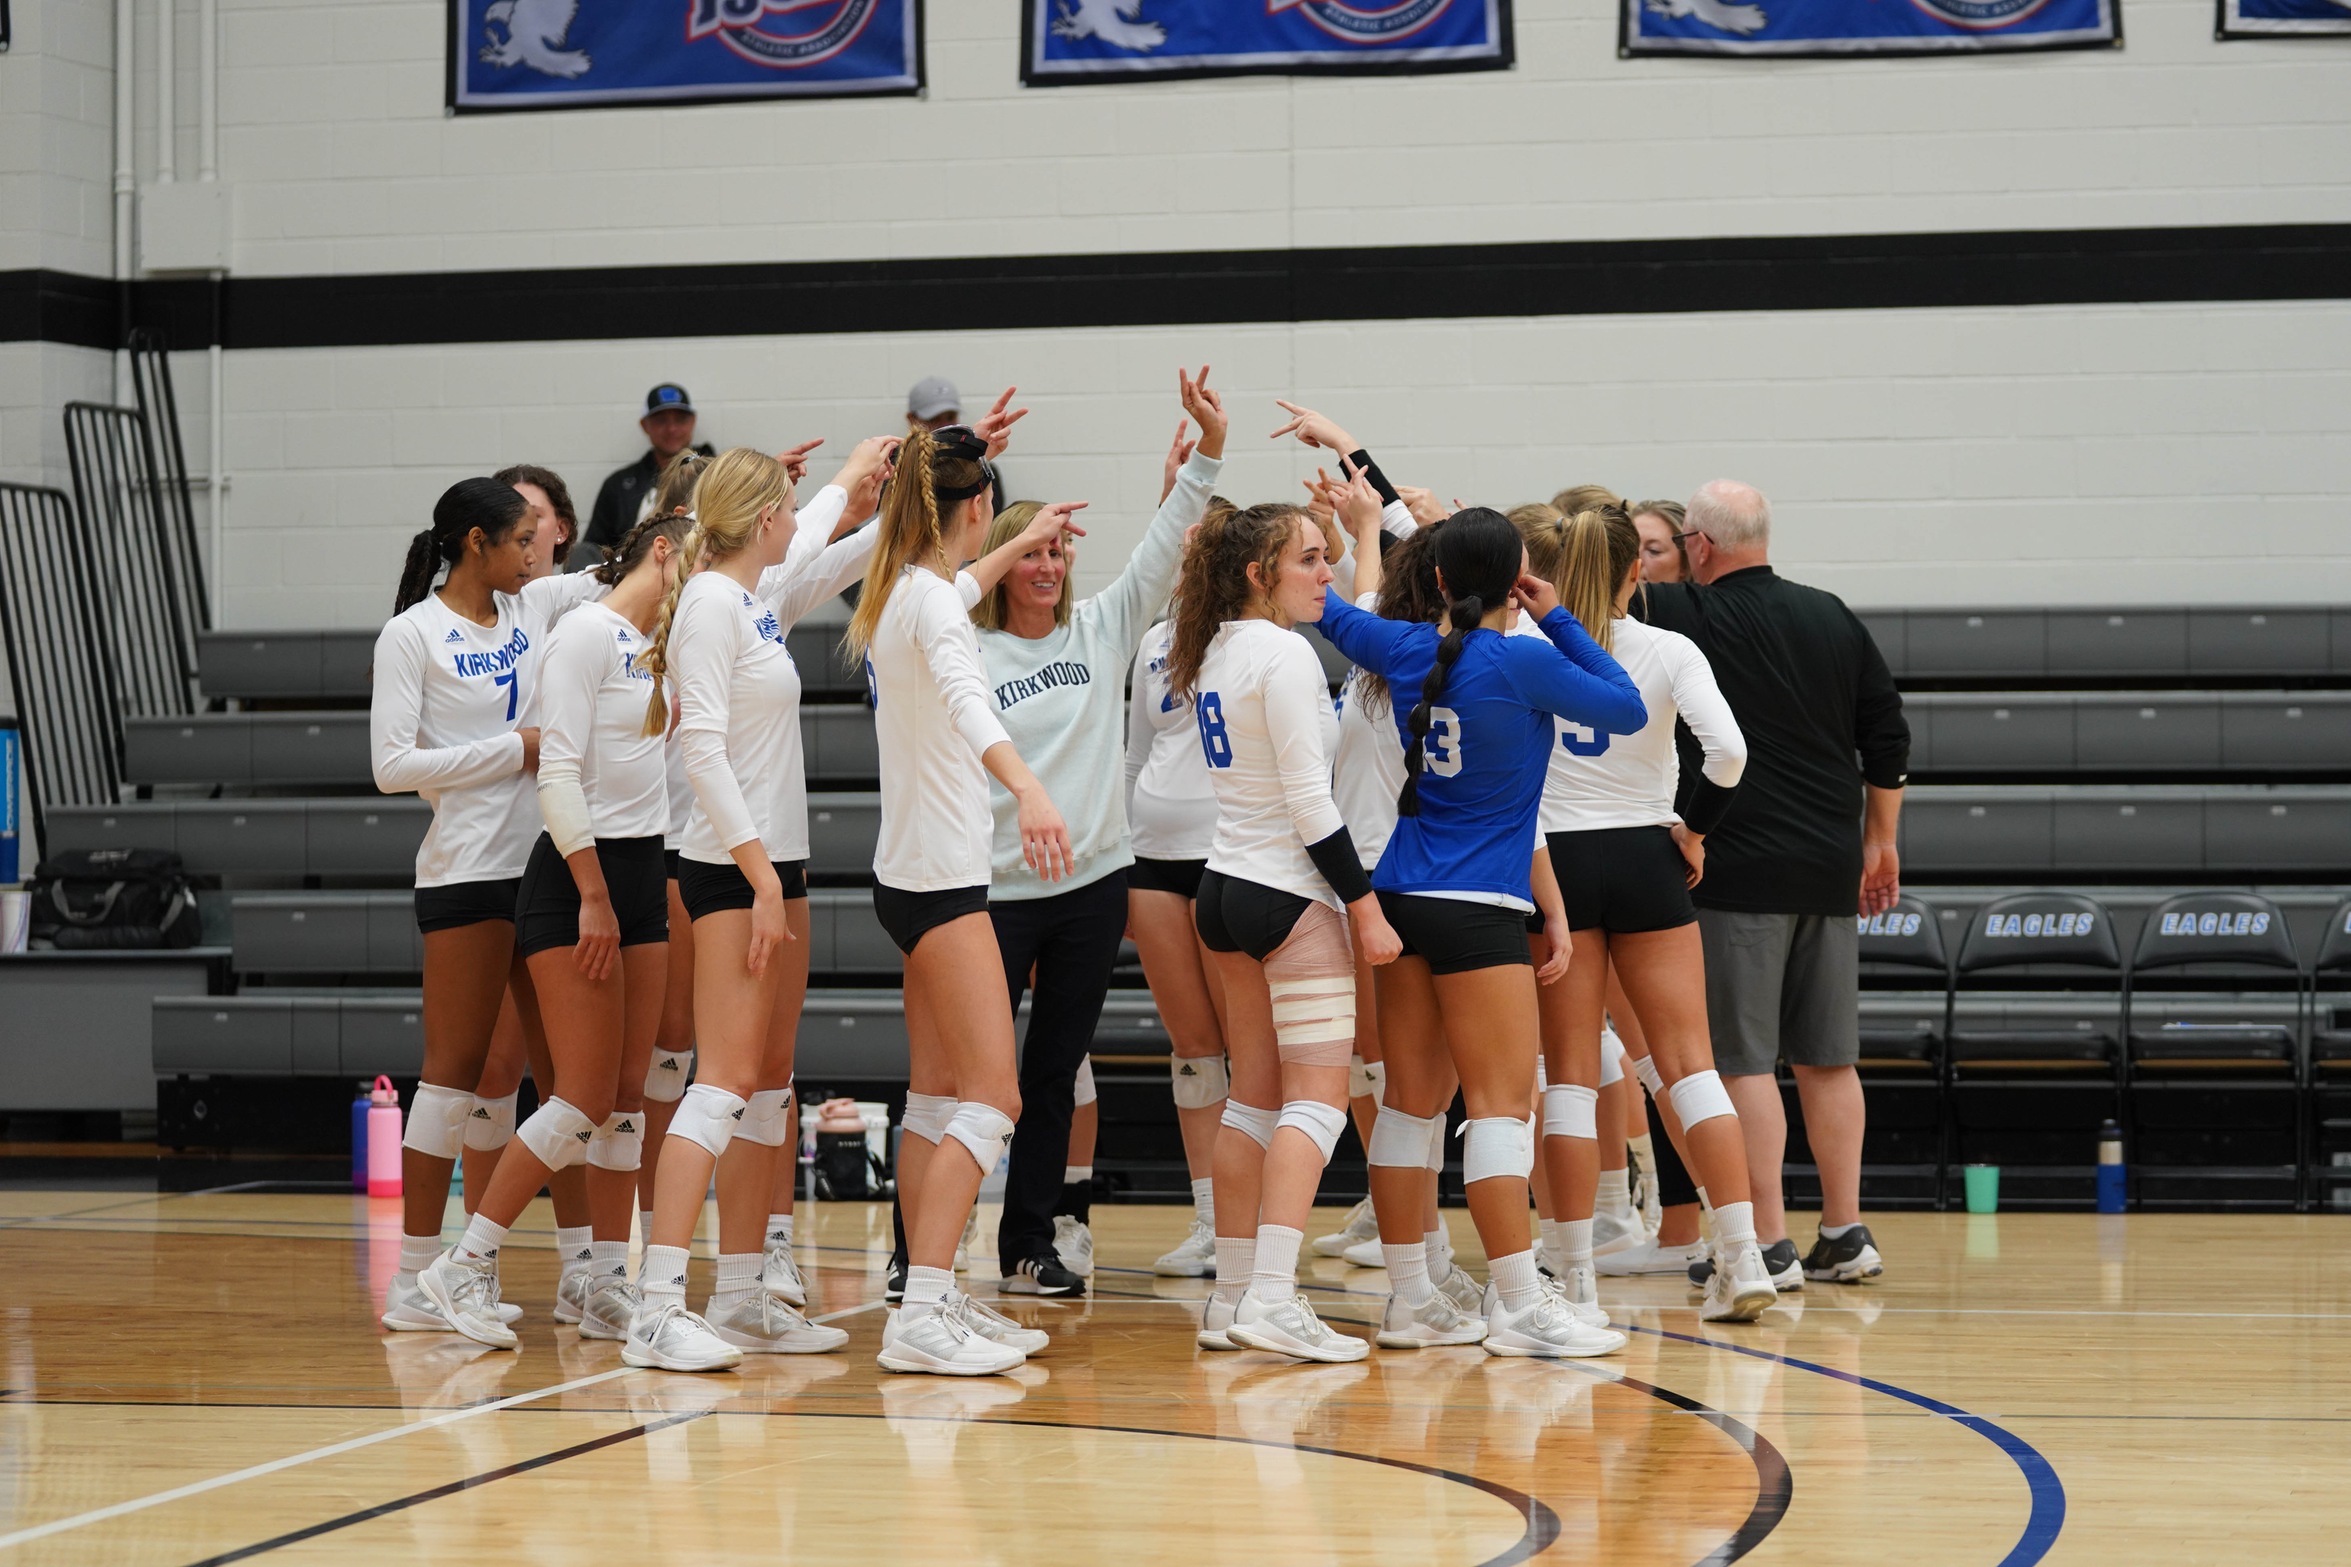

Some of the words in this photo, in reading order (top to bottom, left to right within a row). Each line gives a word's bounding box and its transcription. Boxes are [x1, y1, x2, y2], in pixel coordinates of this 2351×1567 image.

[453, 627, 529, 678] KIRKWOOD
[494, 667, 518, 722] 7
[994, 661, 1091, 711] KIRKWOOD
[1196, 691, 1234, 769] 18
[1411, 703, 1463, 778] 3
[1984, 912, 2095, 938] EAGLES
[2160, 911, 2271, 936] EAGLES
